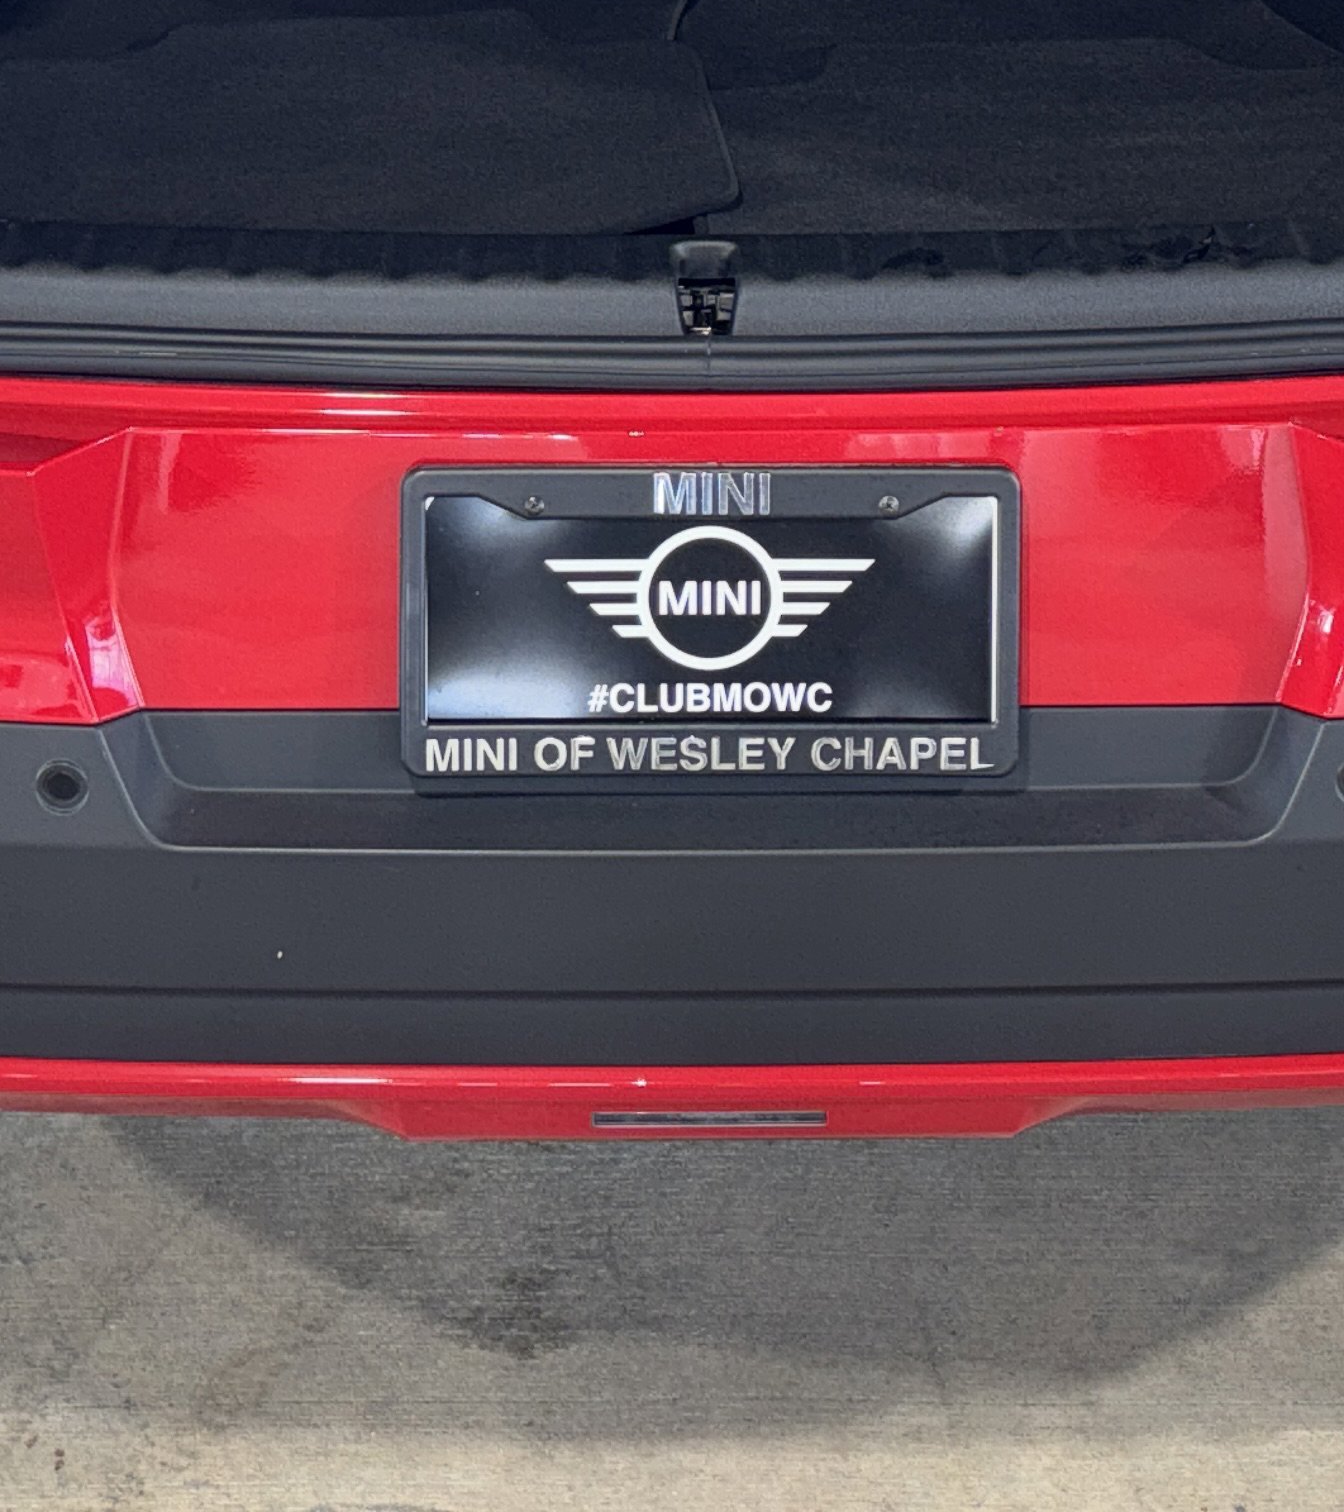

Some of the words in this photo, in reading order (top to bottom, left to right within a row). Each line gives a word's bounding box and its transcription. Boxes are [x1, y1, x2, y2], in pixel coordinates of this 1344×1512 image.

[653, 471, 771, 516] MINI
[658, 580, 761, 616] MINI
[587, 681, 833, 714] #CLUBMOWC
[425, 737, 518, 772] MINI
[533, 734, 596, 771] OF
[606, 735, 796, 772] WESLEY
[810, 736, 996, 772] CHAPEL
